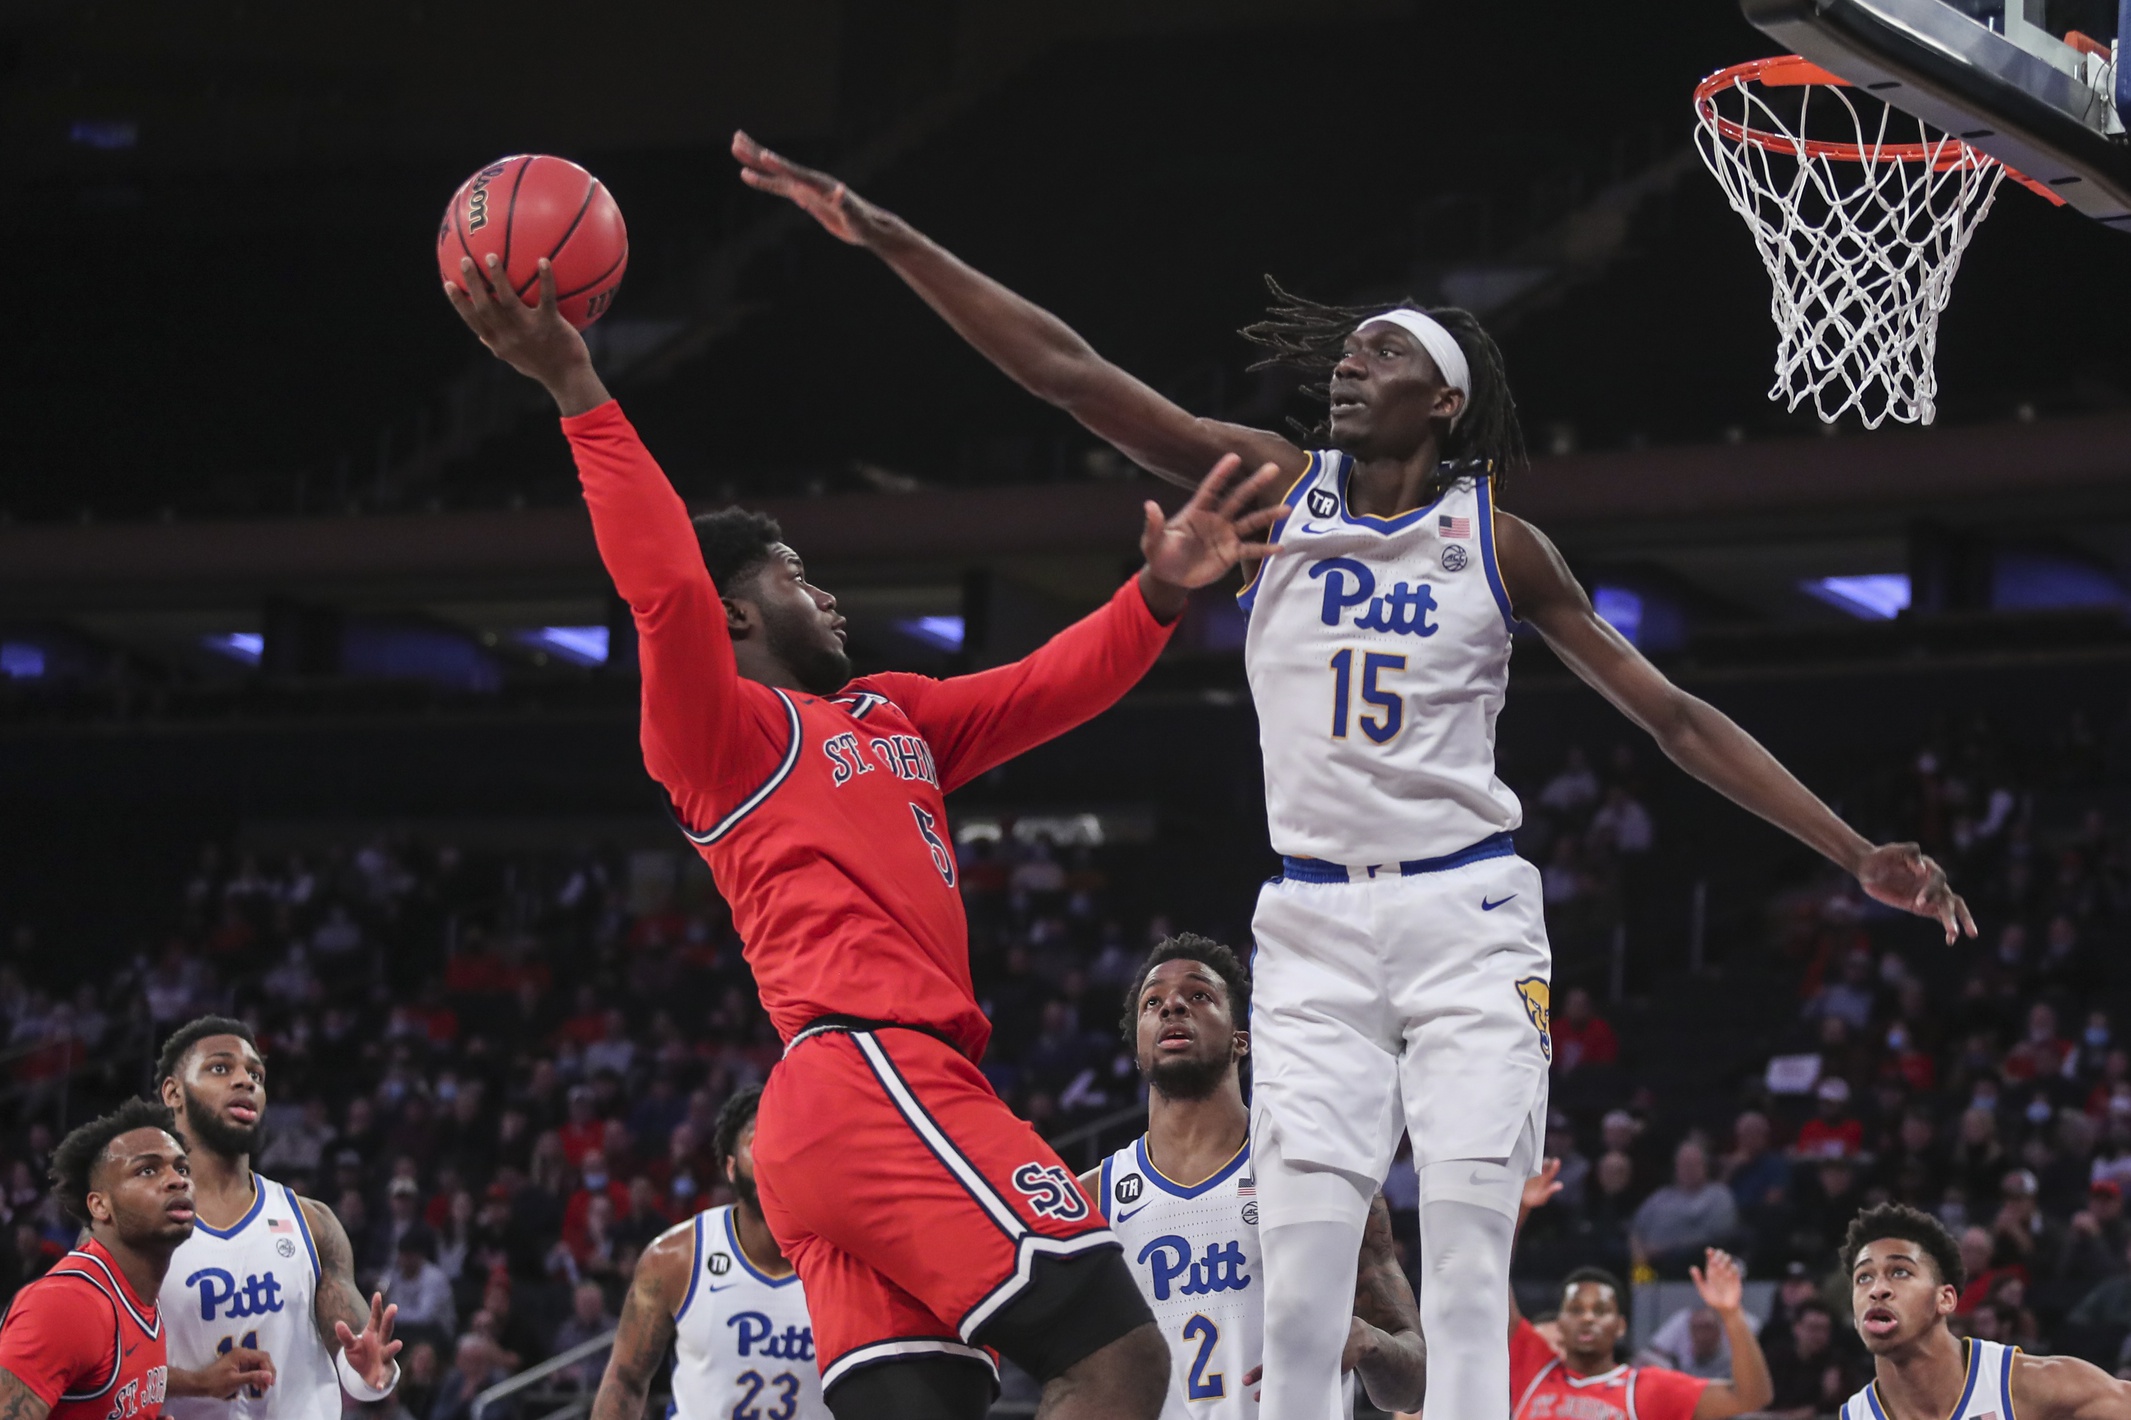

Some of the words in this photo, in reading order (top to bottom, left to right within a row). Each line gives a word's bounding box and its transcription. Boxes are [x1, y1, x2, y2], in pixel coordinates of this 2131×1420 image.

[1308, 557, 1439, 637] Pitt
[1330, 647, 1409, 746] 15
[823, 731, 875, 788] ST.
[869, 734, 939, 790] OHN
[909, 801, 955, 888] 5
[185, 1267, 285, 1321] Pitt
[1137, 1234, 1251, 1301] Pitt
[726, 1310, 816, 1362] Pitt
[1182, 1312, 1227, 1402] 2
[141, 1365, 168, 1408] JOH
[732, 1369, 802, 1420] 23
